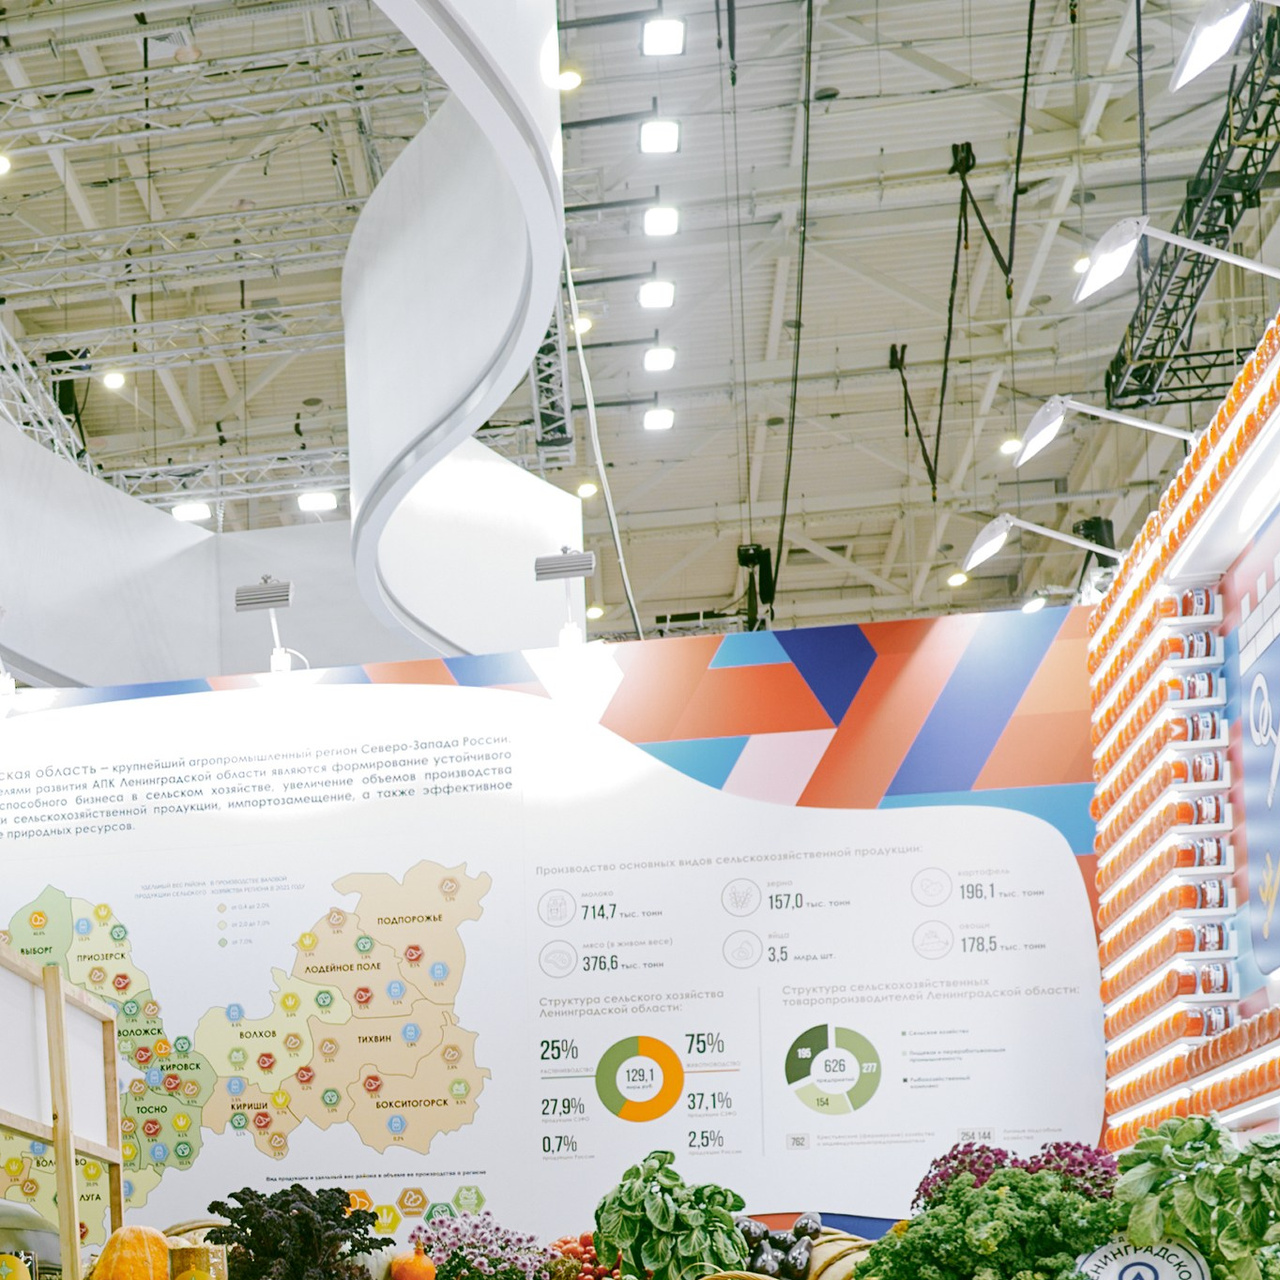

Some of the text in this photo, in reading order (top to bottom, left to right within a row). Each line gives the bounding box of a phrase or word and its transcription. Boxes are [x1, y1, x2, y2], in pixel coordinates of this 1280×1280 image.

[36, 764, 96, 778] область
[112, 757, 186, 774] крупнейший
[188, 748, 312, 769] агропромышленный
[316, 747, 358, 759] регион
[361, 739, 460, 755] Северо-Запада
[463, 735, 511, 747] России.
[36, 782, 88, 795] развития
[92, 778, 115, 789] АПК
[120, 771, 212, 788] Ленинградской
[216, 769, 266, 781] области
[271, 764, 327, 776] являются
[332, 757, 429, 774] формирование
[433, 750, 512, 767] устойчивого
[75, 793, 124, 806] бизнеса
[131, 794, 138, 802] в
[145, 788, 204, 801] сельском
[211, 782, 275, 796] хозяйстве,
[282, 776, 354, 792] увеличение
[362, 771, 417, 785] объемов
[424, 764, 513, 782] производства
[13, 804, 147, 824] сельскохозяйственной
[153, 801, 222, 817] продукции,
[227, 790, 355, 810] импортозамещение,
[362, 790, 370, 800] а
[376, 786, 416, 799] также
[422, 779, 513, 796] эффективное
[7, 825, 73, 841] природных
[75, 821, 136, 836] ресурсов.
[536, 862, 616, 877] Производство
[620, 860, 676, 871] основных
[679, 856, 713, 868] видов
[715, 848, 851, 866] сельскохозяйственной
[958, 866, 1010, 878] картофель
[767, 879, 793, 889] зерно
[960, 883, 995, 901] 196,1
[1022, 889, 1045, 897] тонн
[768, 893, 804, 911] 157,0
[829, 899, 851, 907] тонн
[377, 914, 443, 926] ПОДПОРОЖЬЕ
[581, 903, 617, 920] 714,7
[620, 911, 640, 919] тыс.
[960, 922, 991, 931] овощи
[21, 946, 54, 956] ВЫБОРГ
[582, 937, 674, 949] мясо живом весе)
[962, 935, 998, 953] 178,5
[1024, 942, 1046, 950] тонн
[77, 952, 127, 962] ПРИОЗЕРСК
[582, 954, 619, 972] 376,6
[621, 962, 640, 970] тыс.
[768, 946, 818, 963] 3,5 млрд
[305, 962, 381, 974] ЛОДЕЙНОЕ ПОЛЕ
[782, 977, 990, 997] Структура сельскохозяйственных
[539, 990, 724, 1008] Структура сельского хозяйства
[782, 991, 924, 1008] товаропроизводителей
[926, 986, 1021, 1003] Ленинградской
[539, 1005, 628, 1018] Ленинградской
[240, 1030, 277, 1039] ВОЛХОВ
[358, 1034, 392, 1044] ТИХВИН
[685, 1032, 725, 1054] 75%
[540, 1039, 579, 1060] 25%
[160, 1062, 201, 1072] КИРОВСК
[824, 1059, 846, 1073] 626
[626, 1068, 654, 1082] 129,1
[137, 1105, 168, 1114] ТОСНО
[231, 1102, 269, 1111] КИРИШИ
[376, 1098, 449, 1109] БОКСИТОГОРСК
[541, 1097, 585, 1117] 27,9%
[687, 1091, 732, 1111] 37,1%
[816, 1097, 829, 1107] 154
[542, 1135, 578, 1154] 0,7%
[688, 1130, 724, 1150] 2,5%
[791, 1136, 806, 1147] 762
[79, 1192, 102, 1202] ЛУГА
